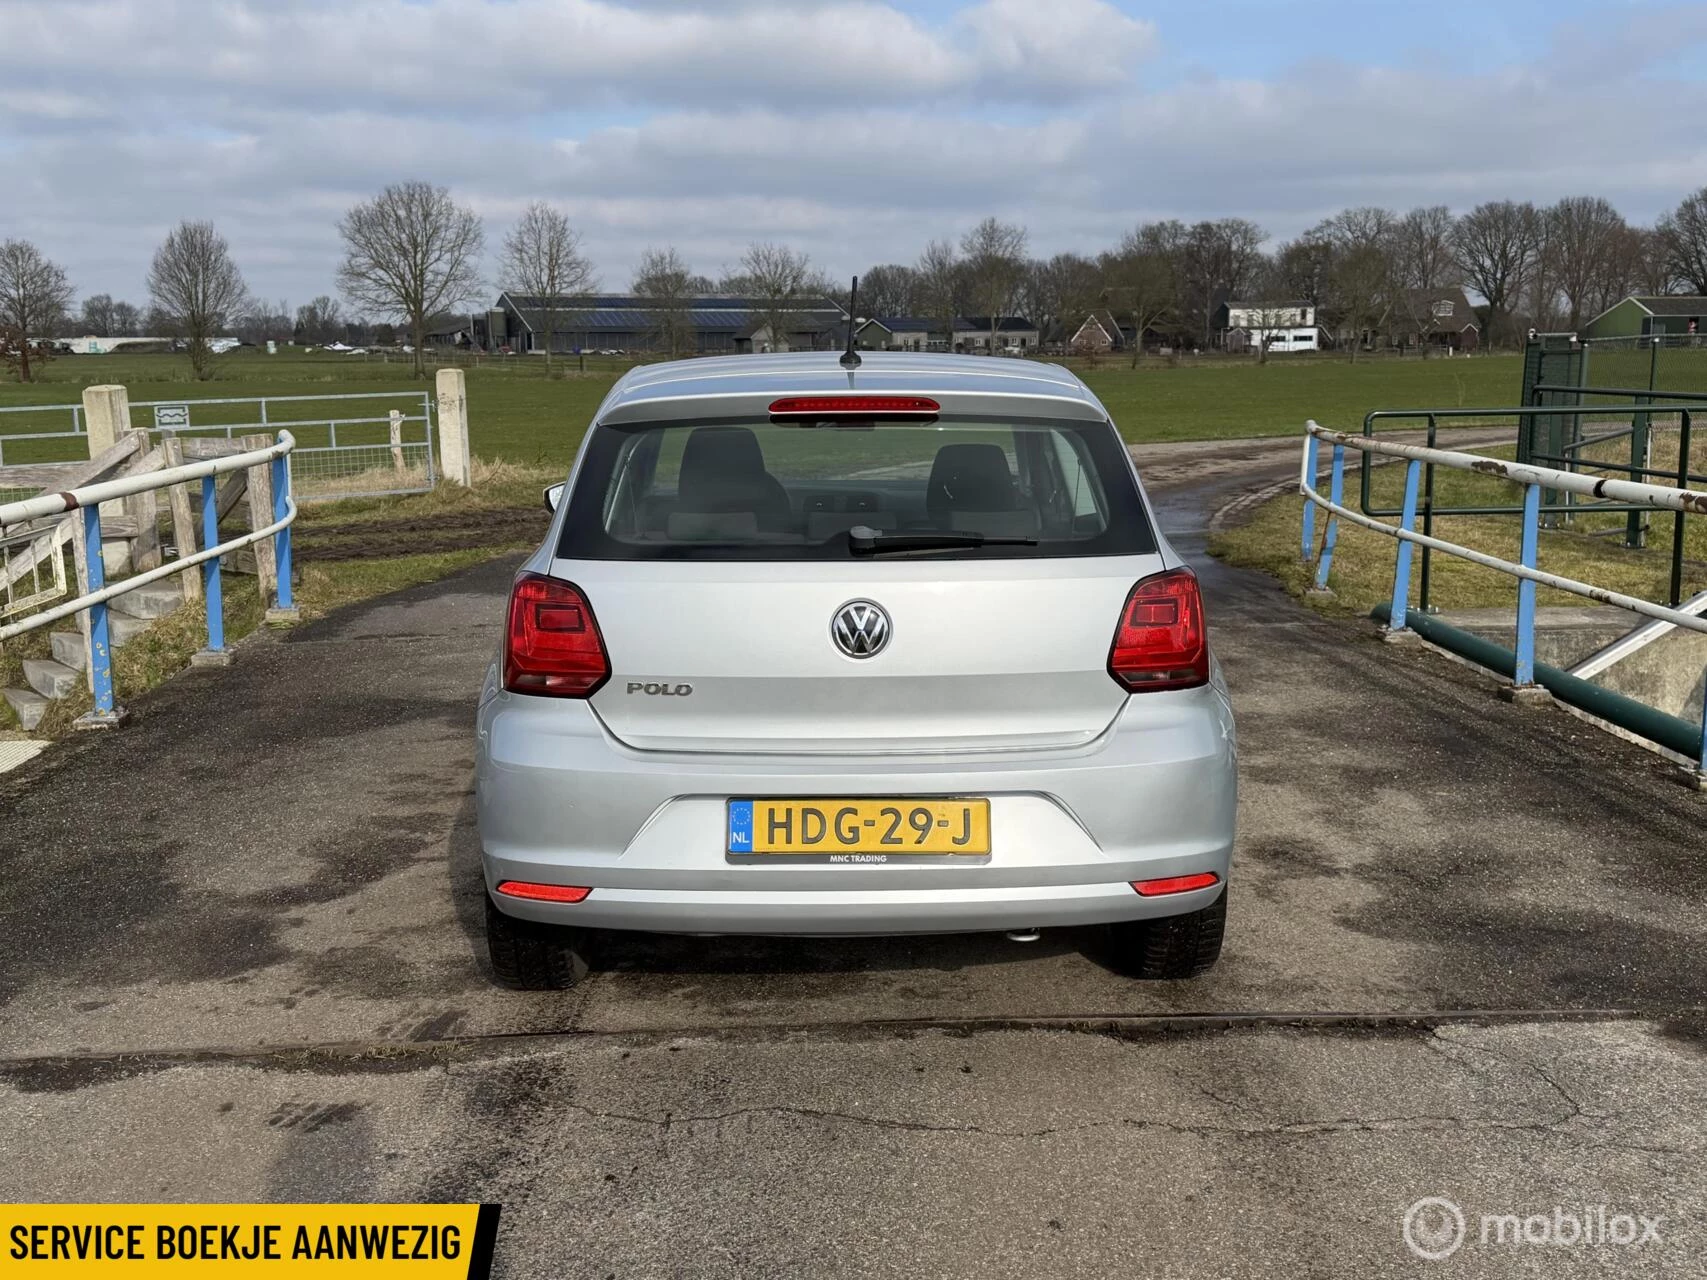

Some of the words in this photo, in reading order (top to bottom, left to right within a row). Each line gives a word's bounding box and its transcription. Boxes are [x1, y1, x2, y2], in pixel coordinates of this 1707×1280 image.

[832, 600, 889, 656] VW
[626, 682, 693, 696] POLO
[767, 807, 971, 845] HDG-29-J
[732, 831, 750, 844] NL
[830, 855, 849, 863] MNC
[851, 855, 887, 863] TRADING
